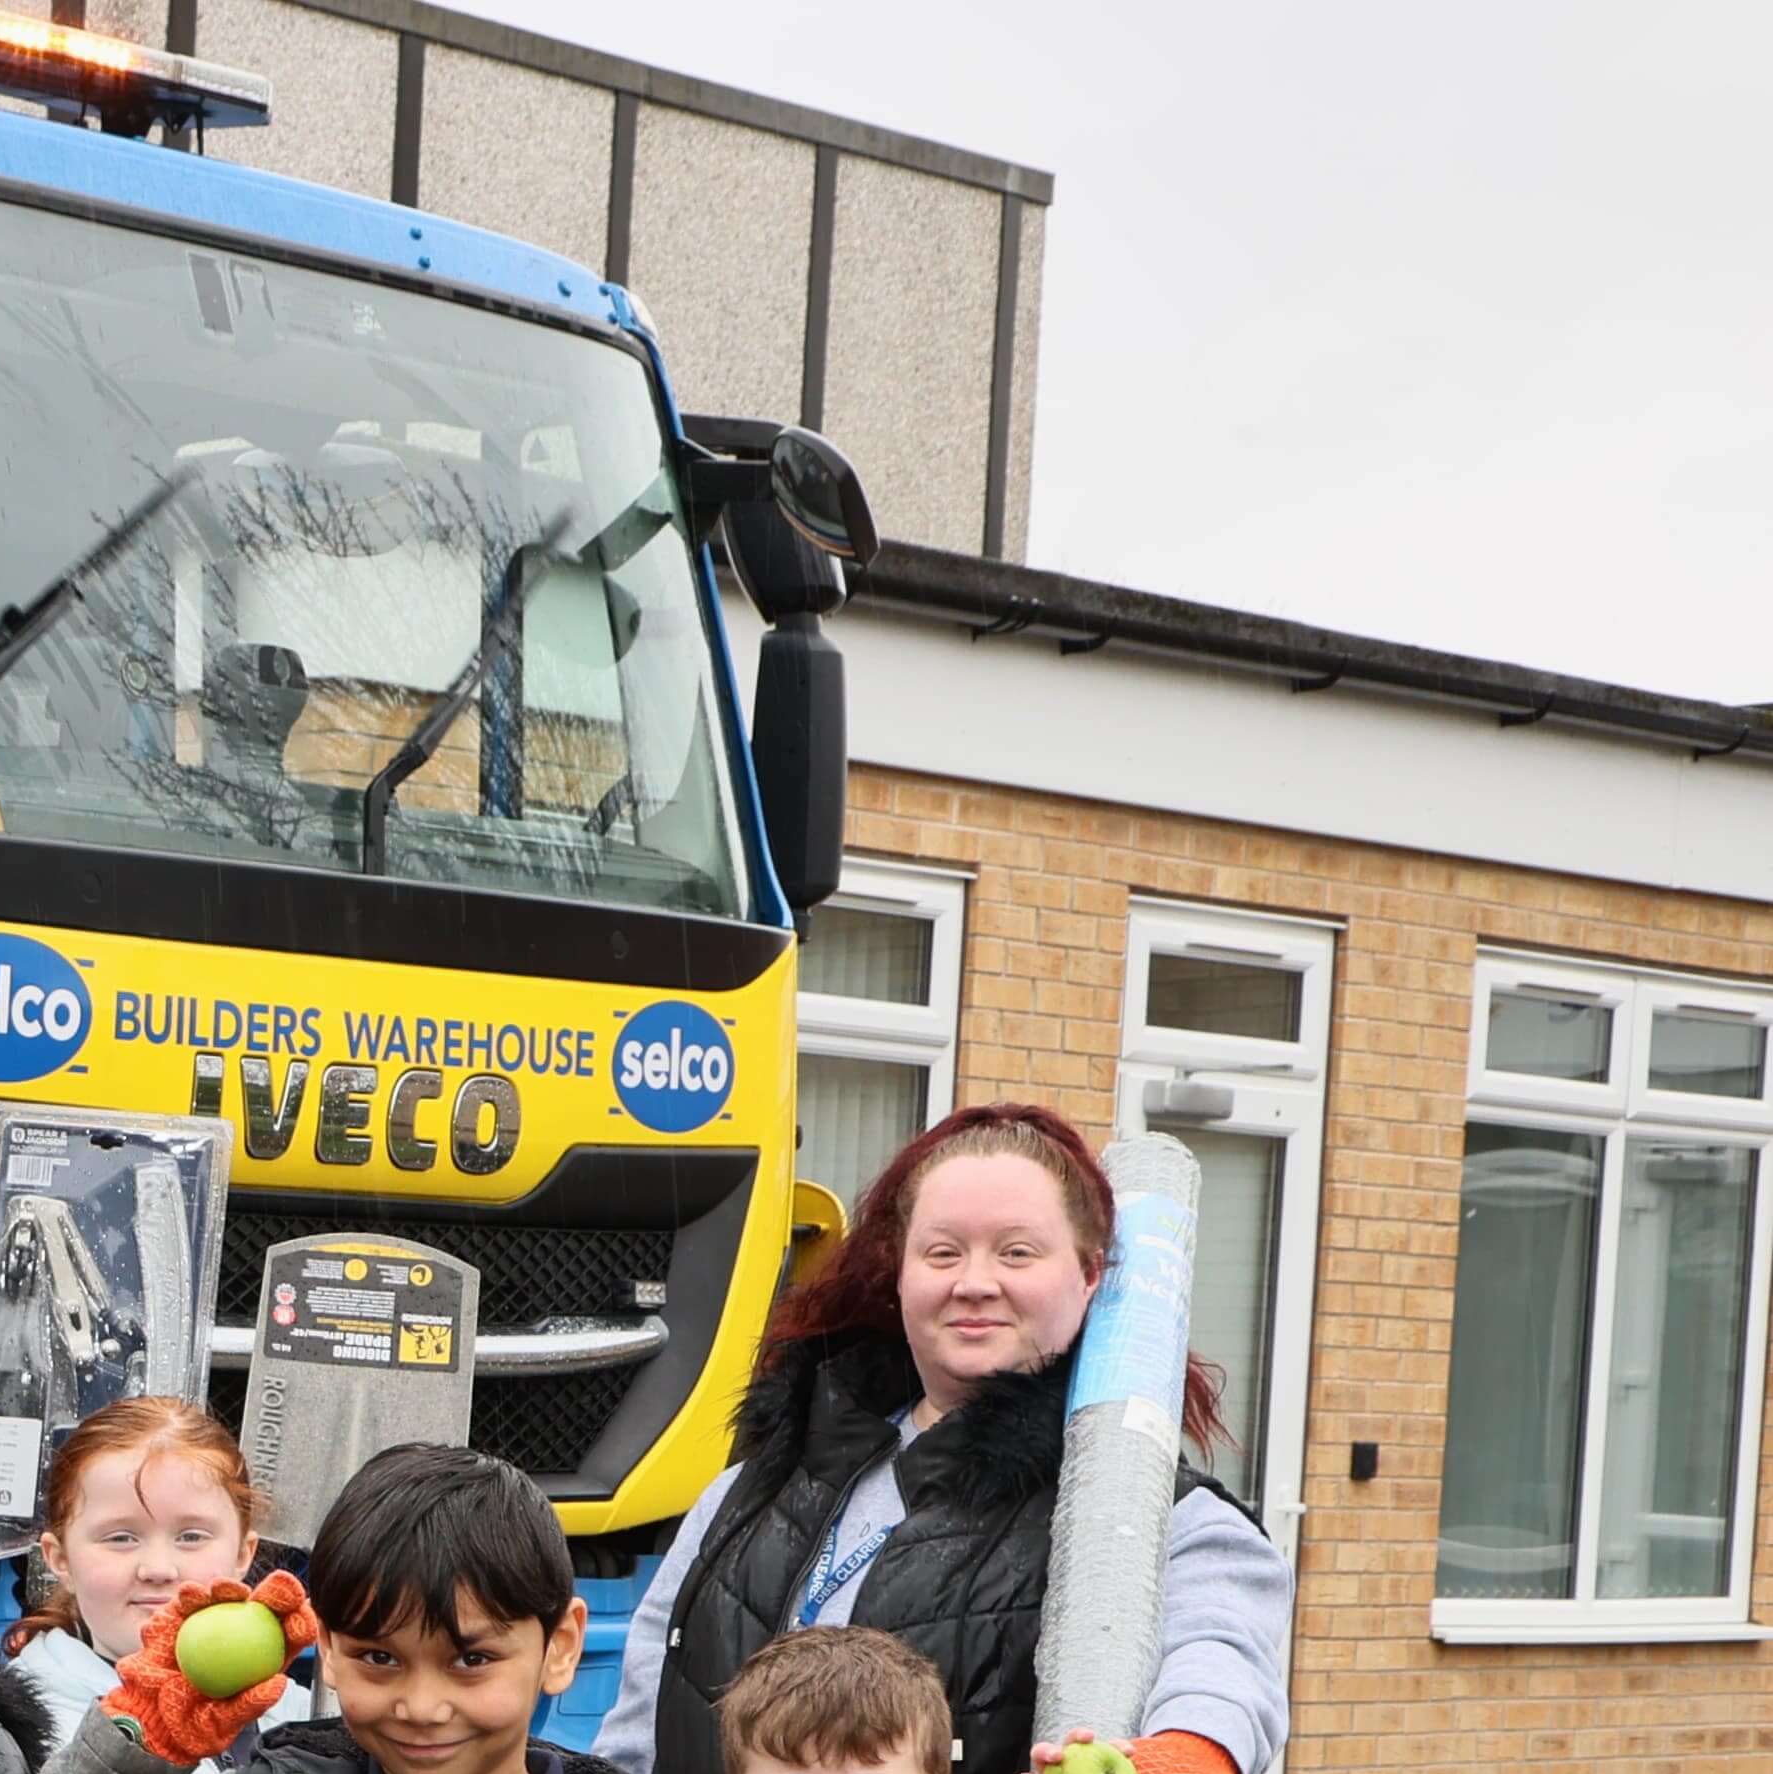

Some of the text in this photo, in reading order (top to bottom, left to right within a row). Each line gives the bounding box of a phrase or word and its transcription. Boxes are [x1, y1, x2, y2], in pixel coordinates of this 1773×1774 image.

[113, 991, 595, 1077] BUILDERS WAREHOUSE
[619, 1028, 730, 1093] selco
[192, 1052, 523, 1176] IVECO
[332, 1344, 392, 1363] DIGGING
[344, 1333, 393, 1349] SPADE
[835, 1530, 888, 1582] CLEARED
